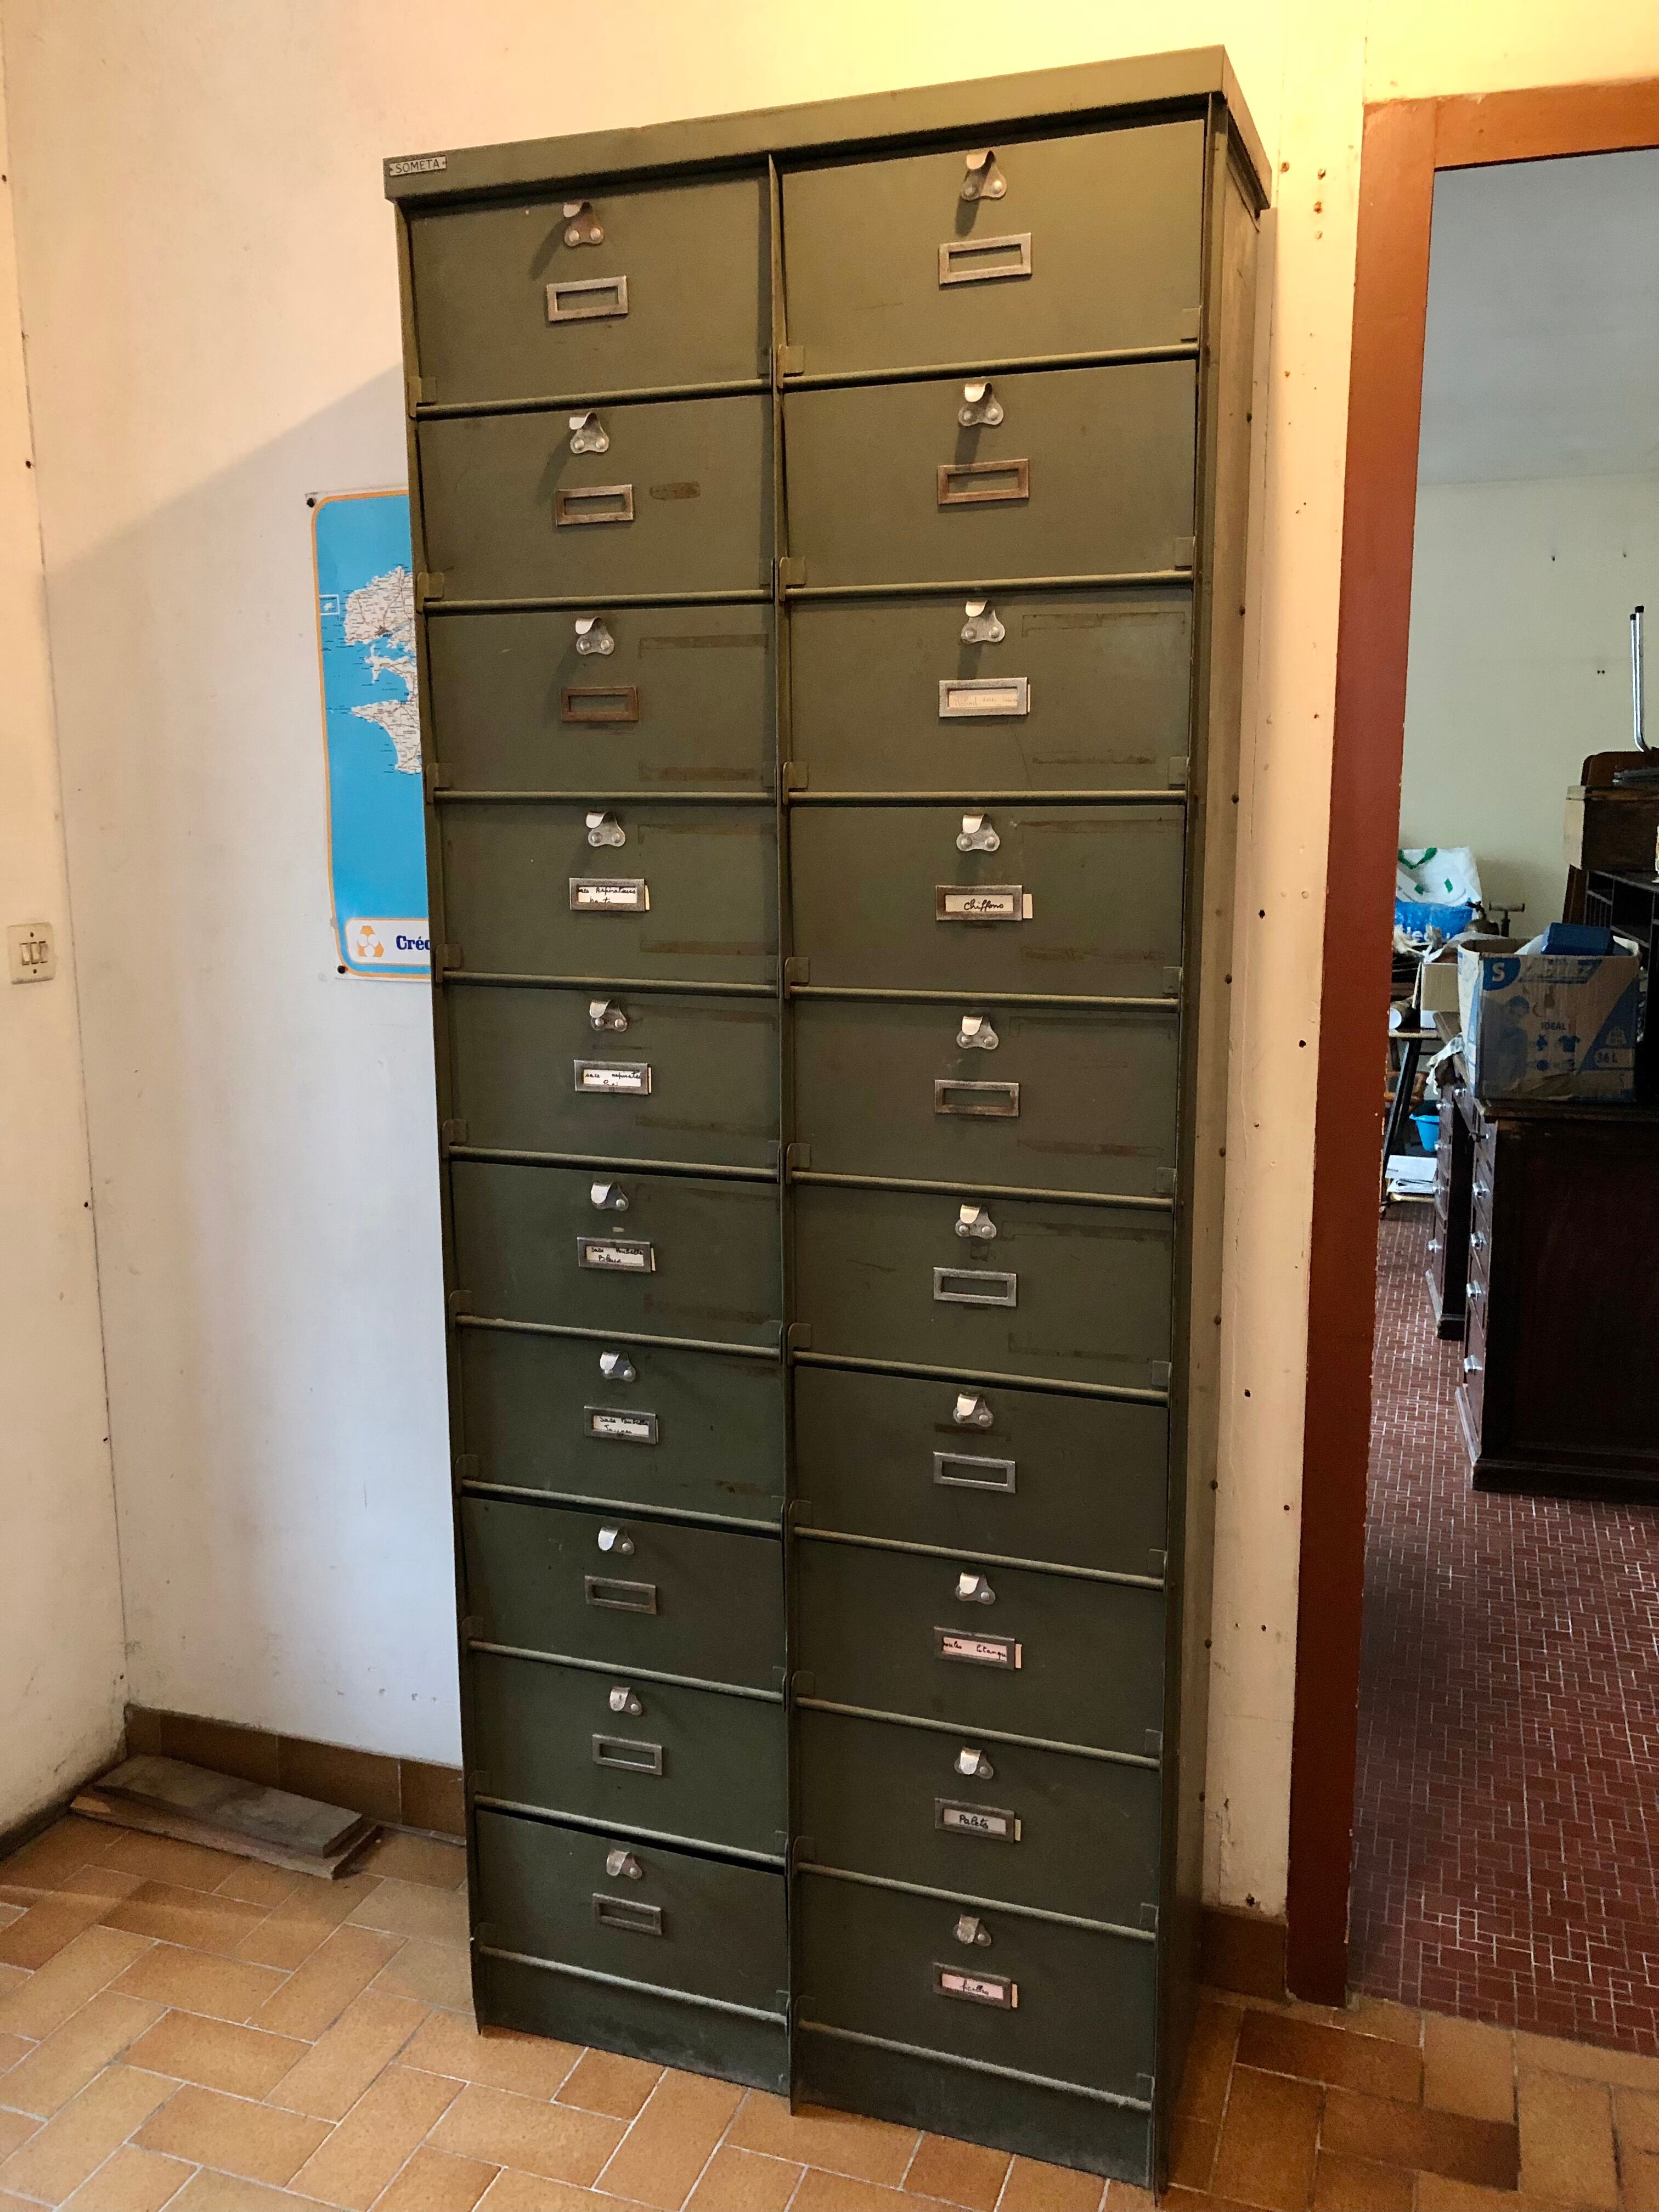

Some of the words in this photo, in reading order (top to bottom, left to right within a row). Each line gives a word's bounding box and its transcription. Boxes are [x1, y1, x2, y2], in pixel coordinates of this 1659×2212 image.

[396, 159, 440, 173] SOMETA
[963, 898, 1005, 912] Chiffons
[1491, 962, 1505, 982] S
